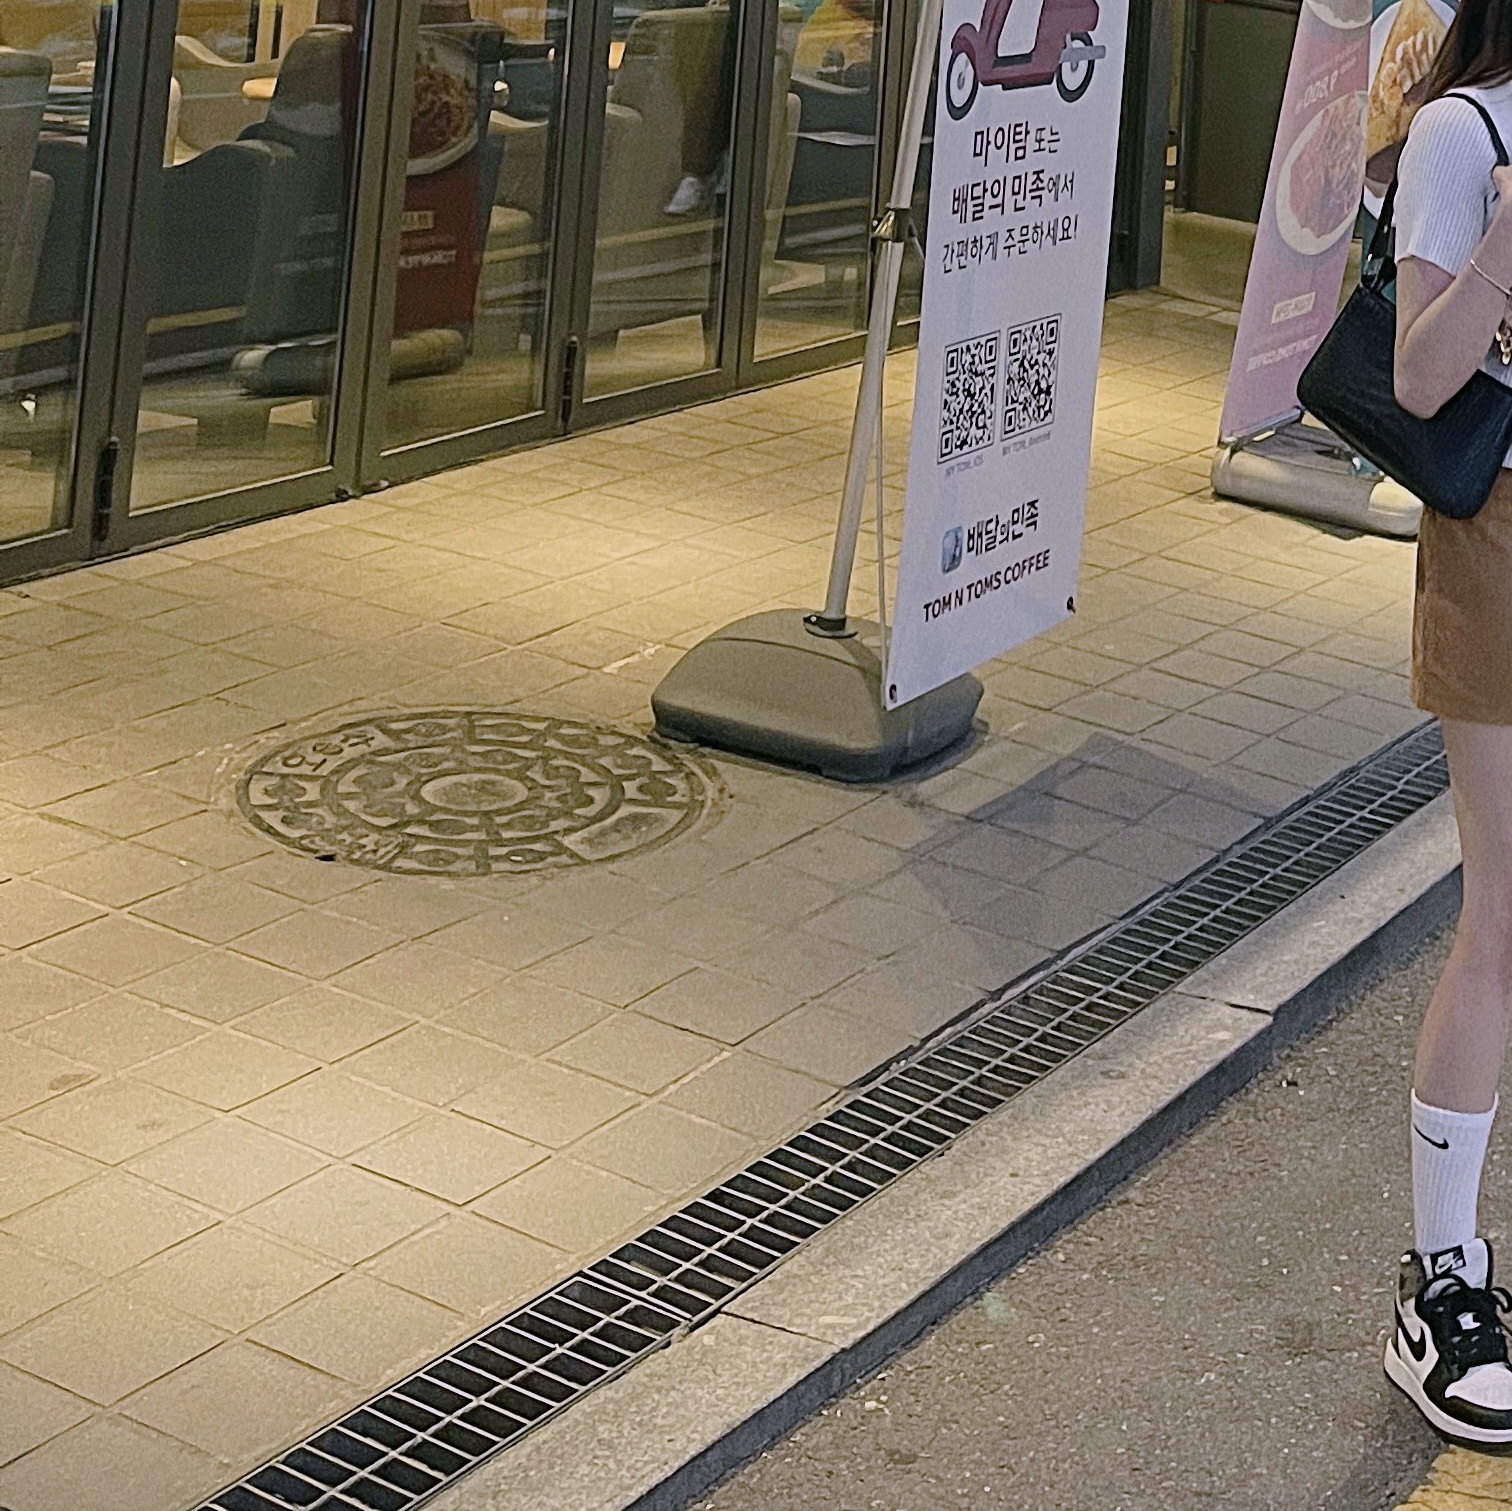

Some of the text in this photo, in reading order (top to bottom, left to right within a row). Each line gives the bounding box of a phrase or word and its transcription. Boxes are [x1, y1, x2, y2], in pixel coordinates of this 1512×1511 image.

[972, 120, 1061, 168] 마이탐 또는
[942, 214, 1079, 275] 간편하게 주문하세요!
[966, 498, 1040, 557] 배달의민족
[922, 592, 952, 623] TOM
[966, 570, 1002, 603] TOMS
[1003, 548, 1051, 585] COFFEE
